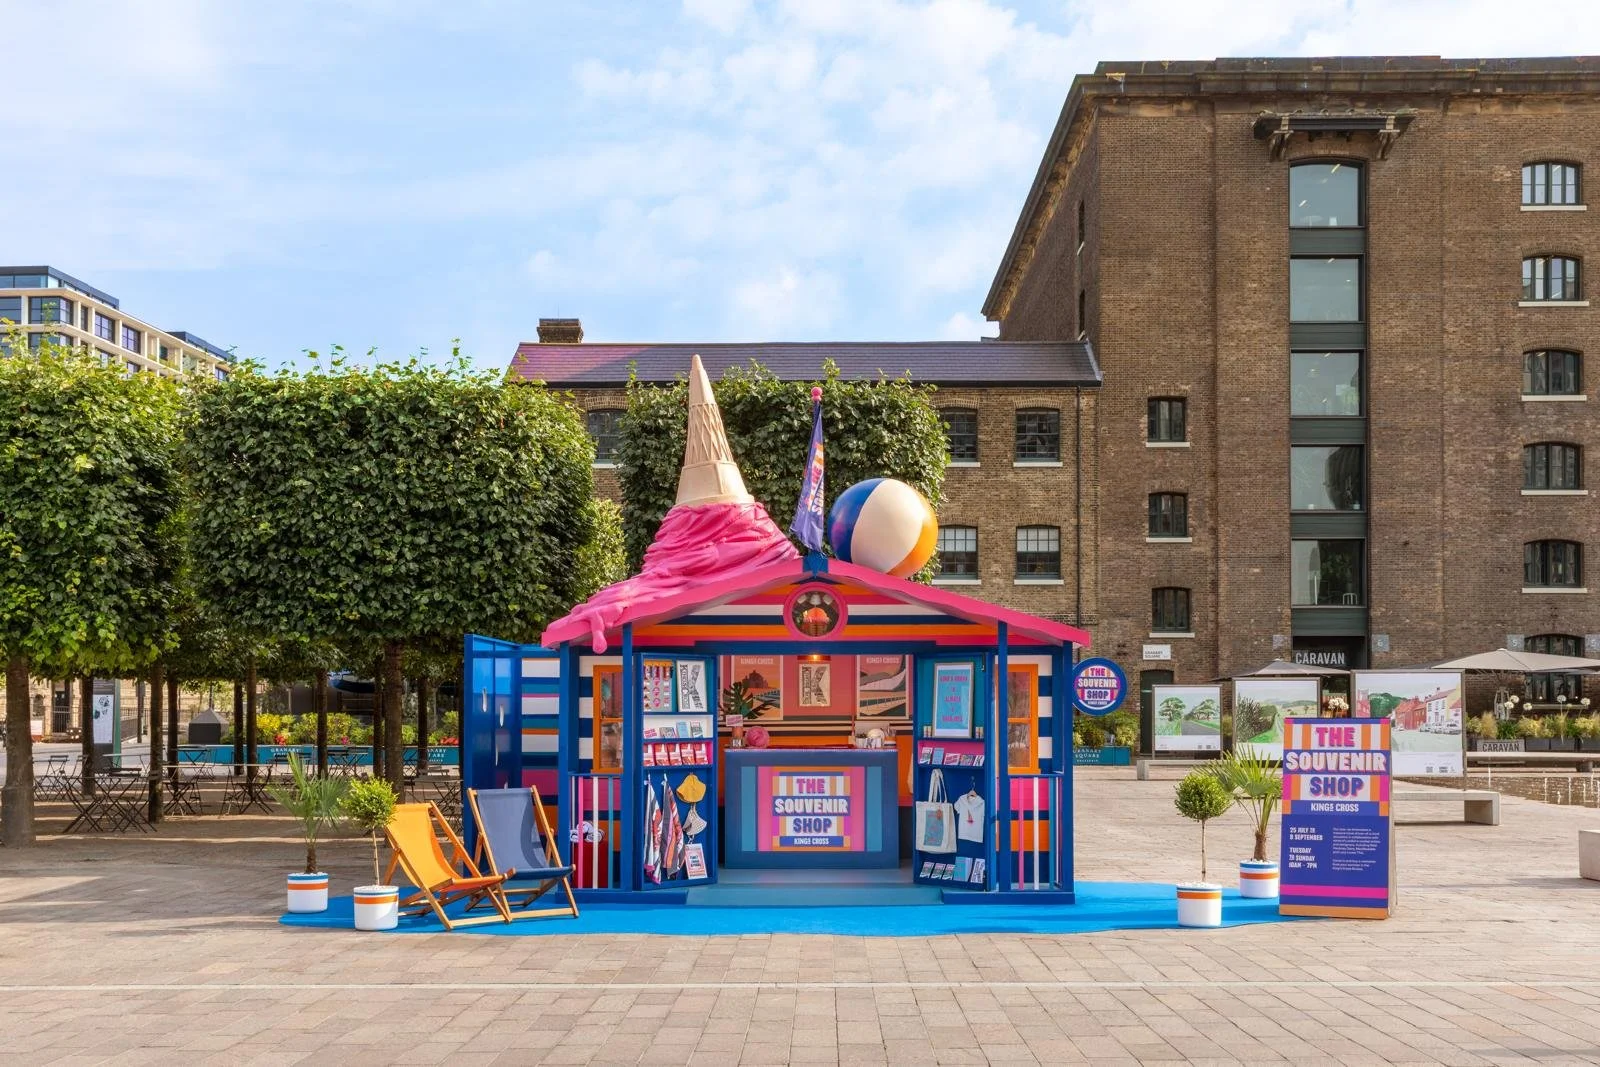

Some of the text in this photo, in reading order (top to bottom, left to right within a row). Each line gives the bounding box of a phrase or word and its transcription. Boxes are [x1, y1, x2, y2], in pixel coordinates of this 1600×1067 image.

[1296, 652, 1344, 664] CARAVAN
[1090, 668, 1106, 676] THE
[1078, 678, 1118, 688] SOUVENIR
[1086, 690, 1108, 700] SHOP
[1316, 727, 1356, 747] THE
[1482, 742, 1520, 752] CARAVAN
[1286, 752, 1386, 772] SOUVENIR
[796, 778, 826, 794] THE
[1310, 776, 1364, 797] SHOP
[775, 799, 848, 814] SOUVENIR
[1336, 803, 1359, 812] CROSS
[793, 818, 832, 833] SHOP
